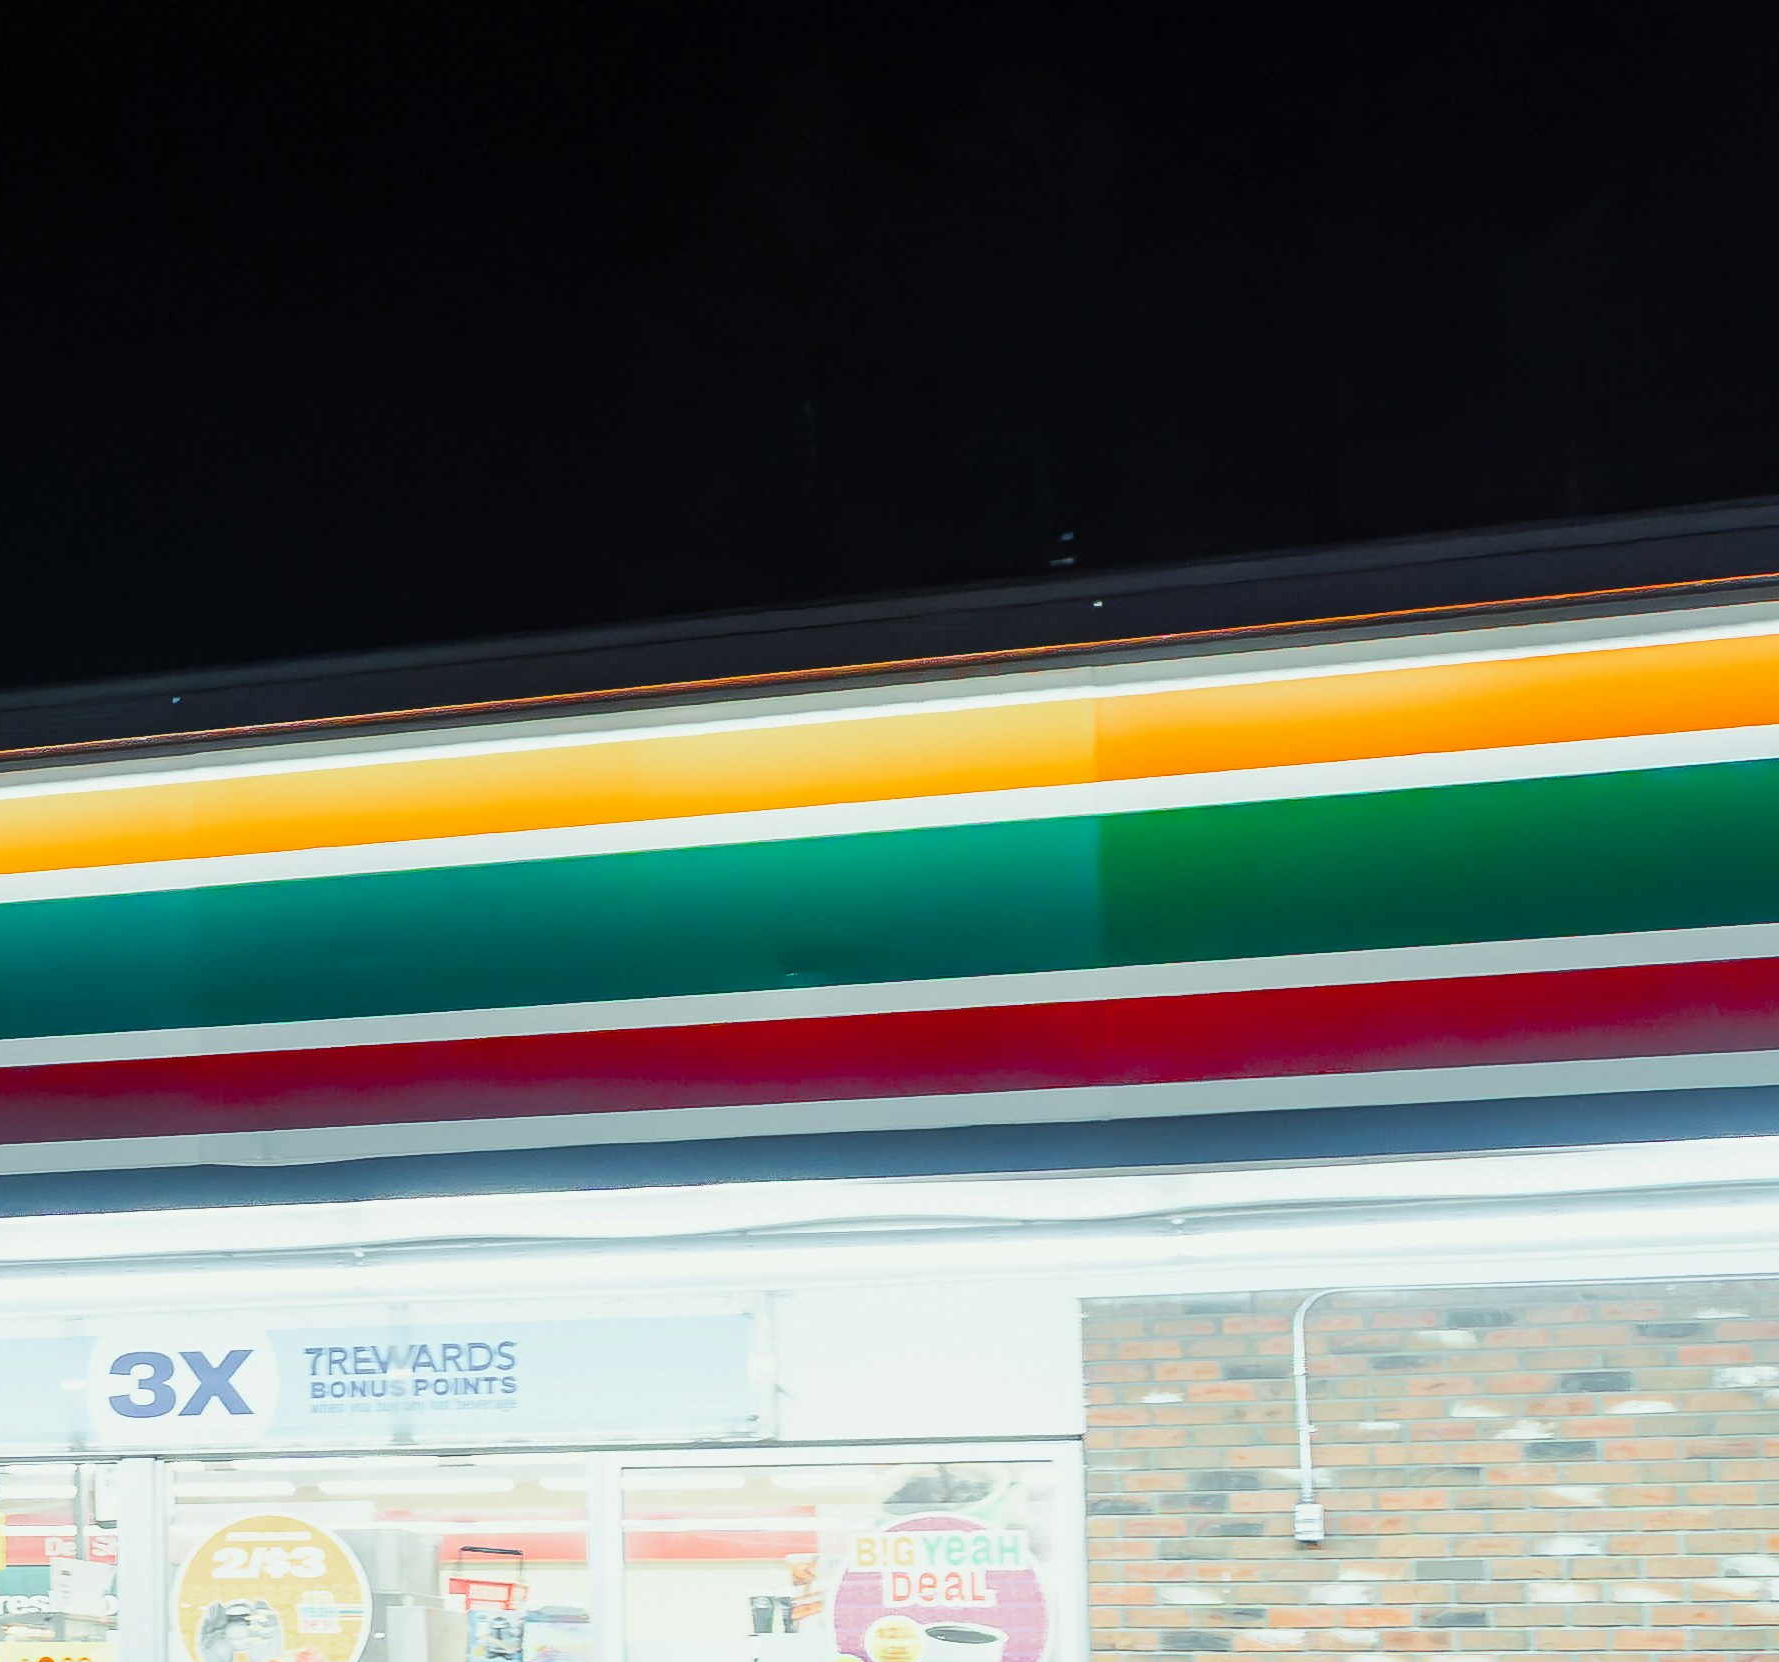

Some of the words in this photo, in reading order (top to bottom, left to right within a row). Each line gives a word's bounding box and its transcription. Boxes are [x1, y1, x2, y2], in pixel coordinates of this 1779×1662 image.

[304, 1341, 518, 1376] 7REWARDS
[108, 1349, 255, 1418] 3X
[310, 1379, 407, 1398] BONUS
[413, 1376, 518, 1396] POINTS
[212, 1546, 328, 1580] 2/$3
[891, 1571, 987, 1602] DeaL
